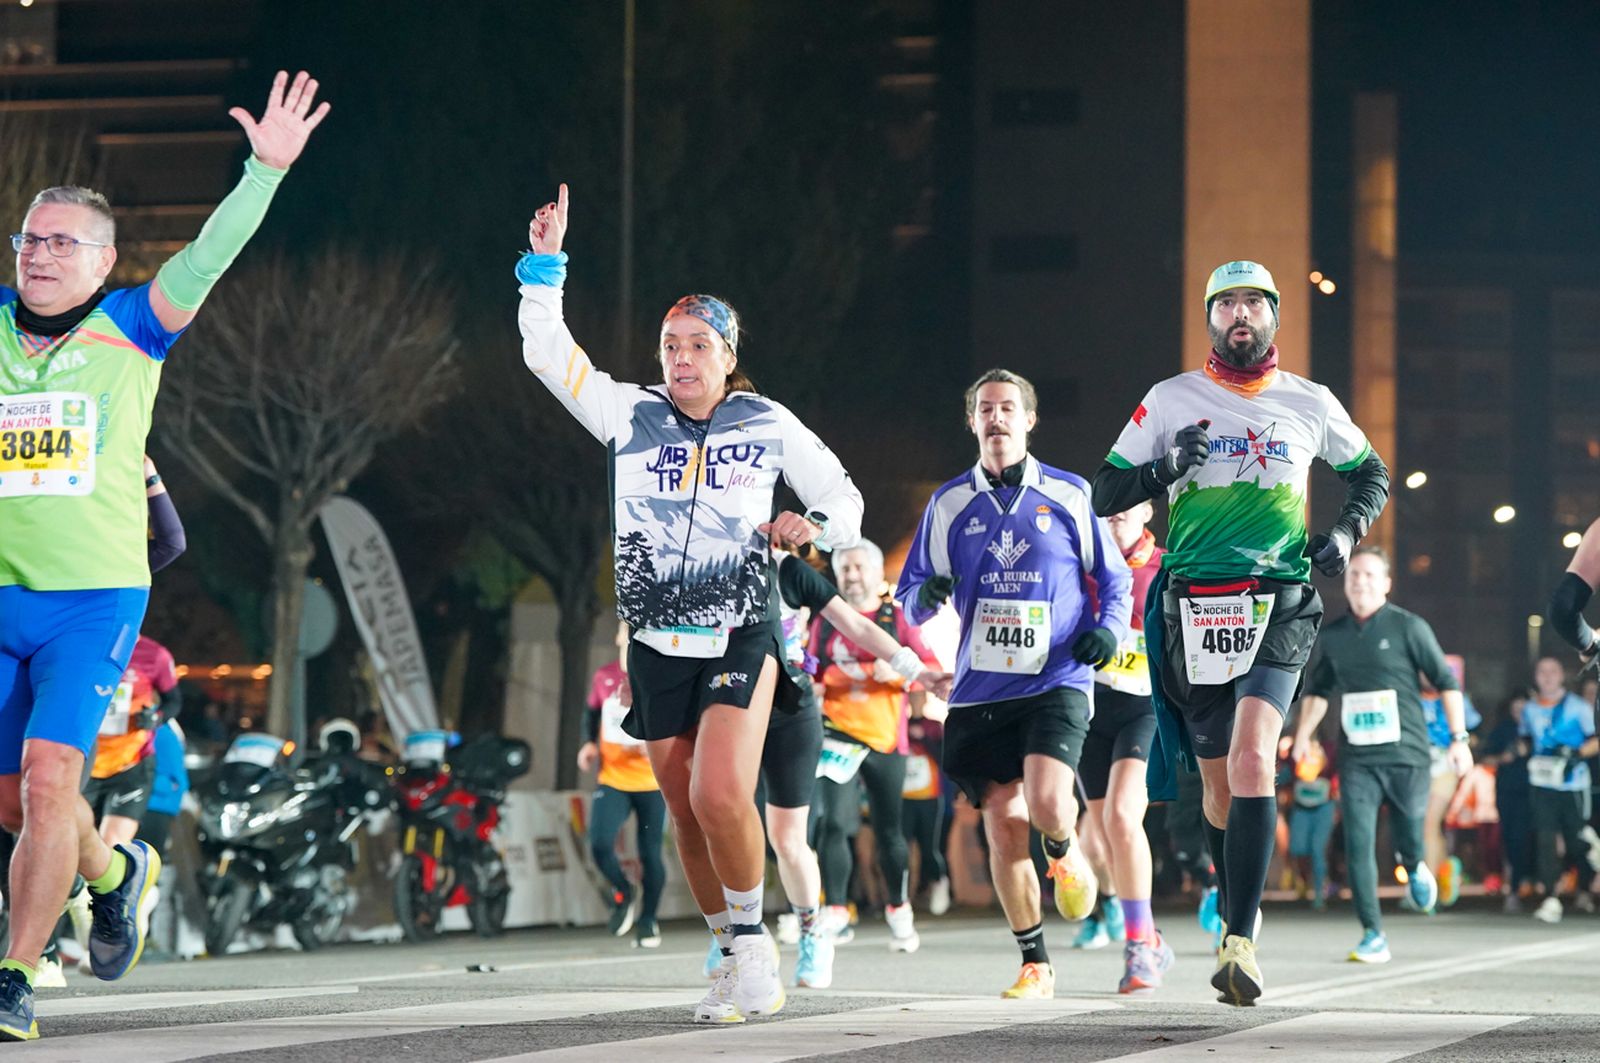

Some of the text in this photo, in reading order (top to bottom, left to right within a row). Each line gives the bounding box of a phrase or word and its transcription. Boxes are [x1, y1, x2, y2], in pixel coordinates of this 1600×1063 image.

[6, 403, 51, 416] NOCHE DE
[0, 419, 14, 429] AN
[1, 430, 72, 461] 3844
[1003, 570, 1043, 584] RURAL
[1203, 605, 1232, 615] NOCHE
[1233, 605, 1244, 615] DE
[981, 615, 995, 625] SAN
[1193, 616, 1212, 627] SAN
[1213, 614, 1245, 627] ANTÓN
[985, 626, 1036, 649] 4448
[1201, 627, 1257, 654] 4685
